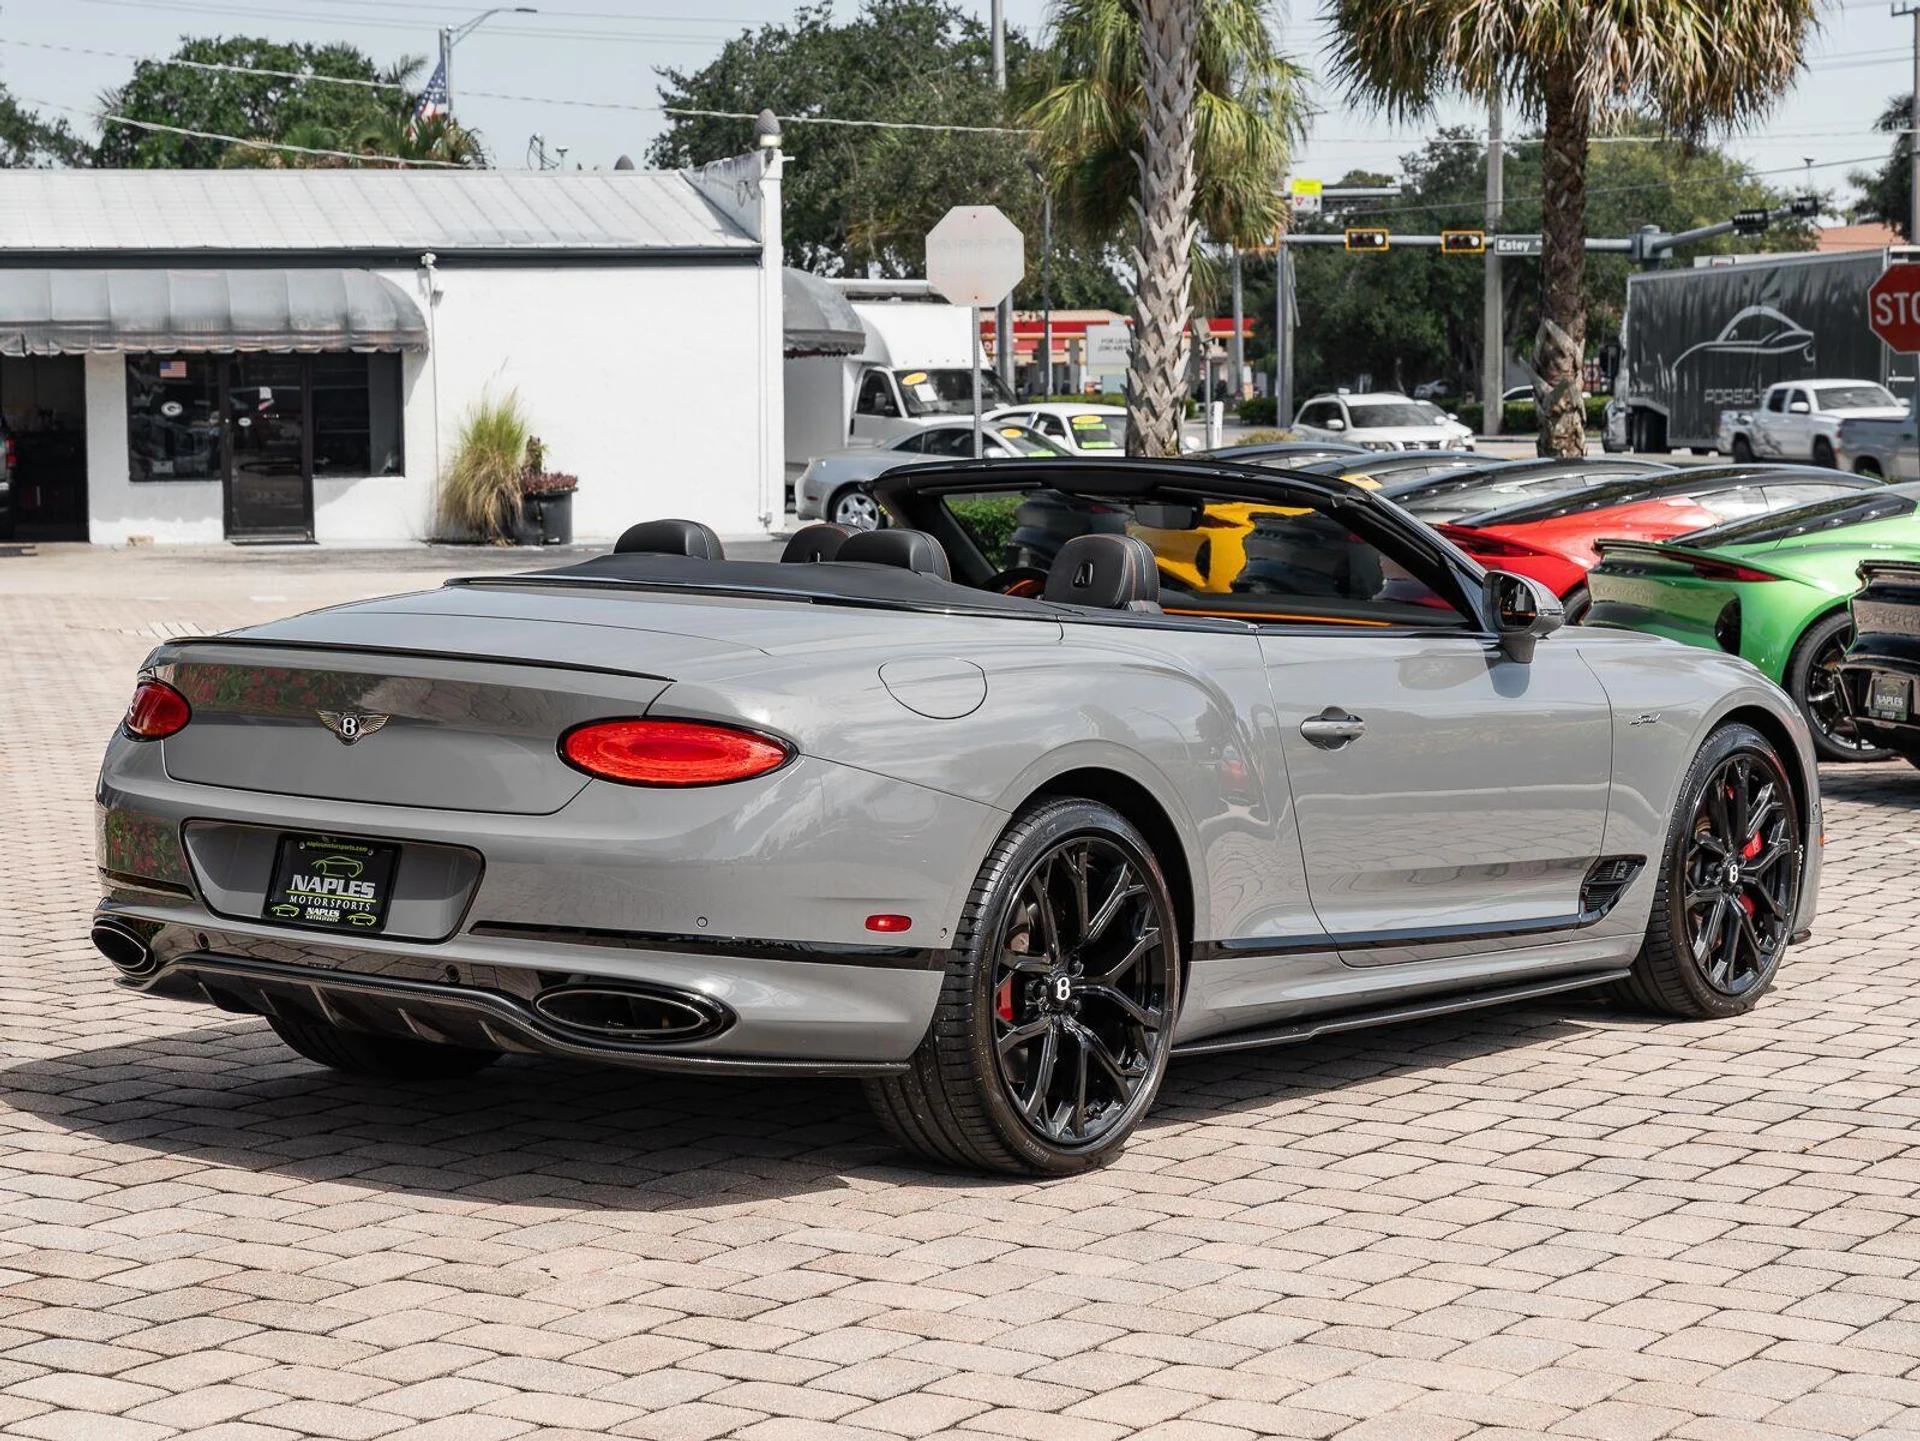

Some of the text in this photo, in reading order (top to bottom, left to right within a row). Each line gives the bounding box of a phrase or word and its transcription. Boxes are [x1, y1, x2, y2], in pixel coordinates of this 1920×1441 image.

[1498, 239, 1530, 252] Estey
[343, 717, 357, 736] B
[290, 874, 376, 899] NAPLES
[288, 895, 371, 912] MOTORSPORTS
[306, 907, 340, 917] NAPLES
[1056, 976, 1071, 1001] B
